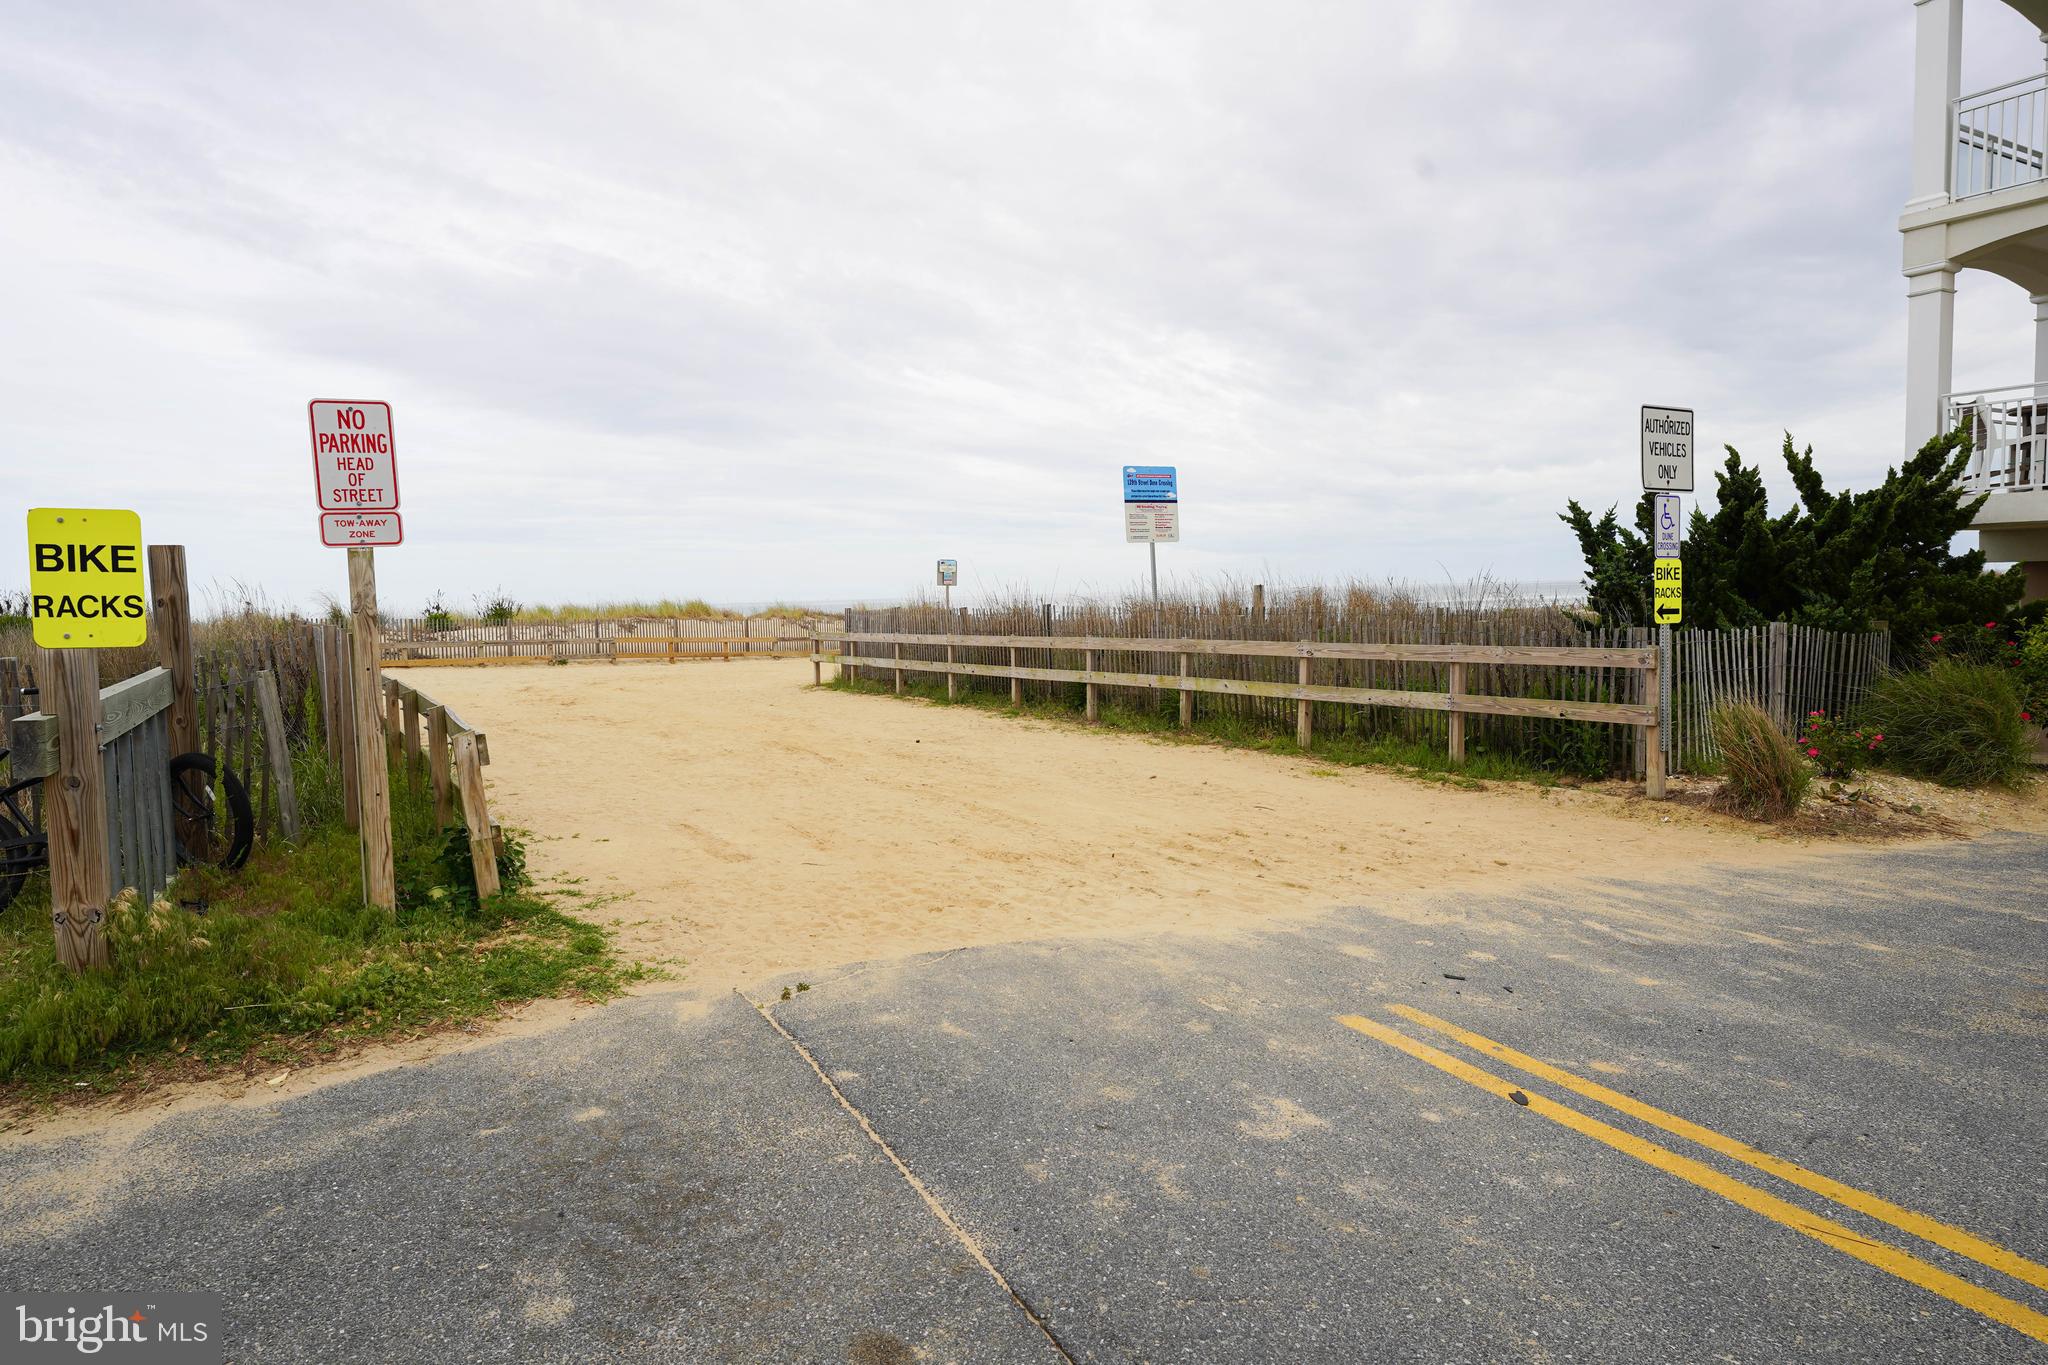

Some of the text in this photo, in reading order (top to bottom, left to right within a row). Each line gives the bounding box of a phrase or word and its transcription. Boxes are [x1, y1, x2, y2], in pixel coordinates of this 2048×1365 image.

[336, 409, 366, 430] NO
[1644, 418, 1691, 436] AUTHORIZED
[319, 433, 388, 454] PARKING
[1648, 441, 1687, 458] VEHICLES
[336, 457, 374, 471] HEAD
[1657, 464, 1678, 480] ONLY
[347, 473, 366, 487] OF
[333, 488, 384, 503] STREET
[334, 519, 388, 528] TOW-AWAY
[349, 530, 376, 538] ZONE
[1662, 532, 1674, 540] DUNE
[1657, 542, 1678, 551] CROSSING
[35, 543, 137, 573] BIKE
[1656, 567, 1680, 581] BIKE
[1655, 587, 1681, 599] RACKS
[33, 594, 144, 619] RACKS
